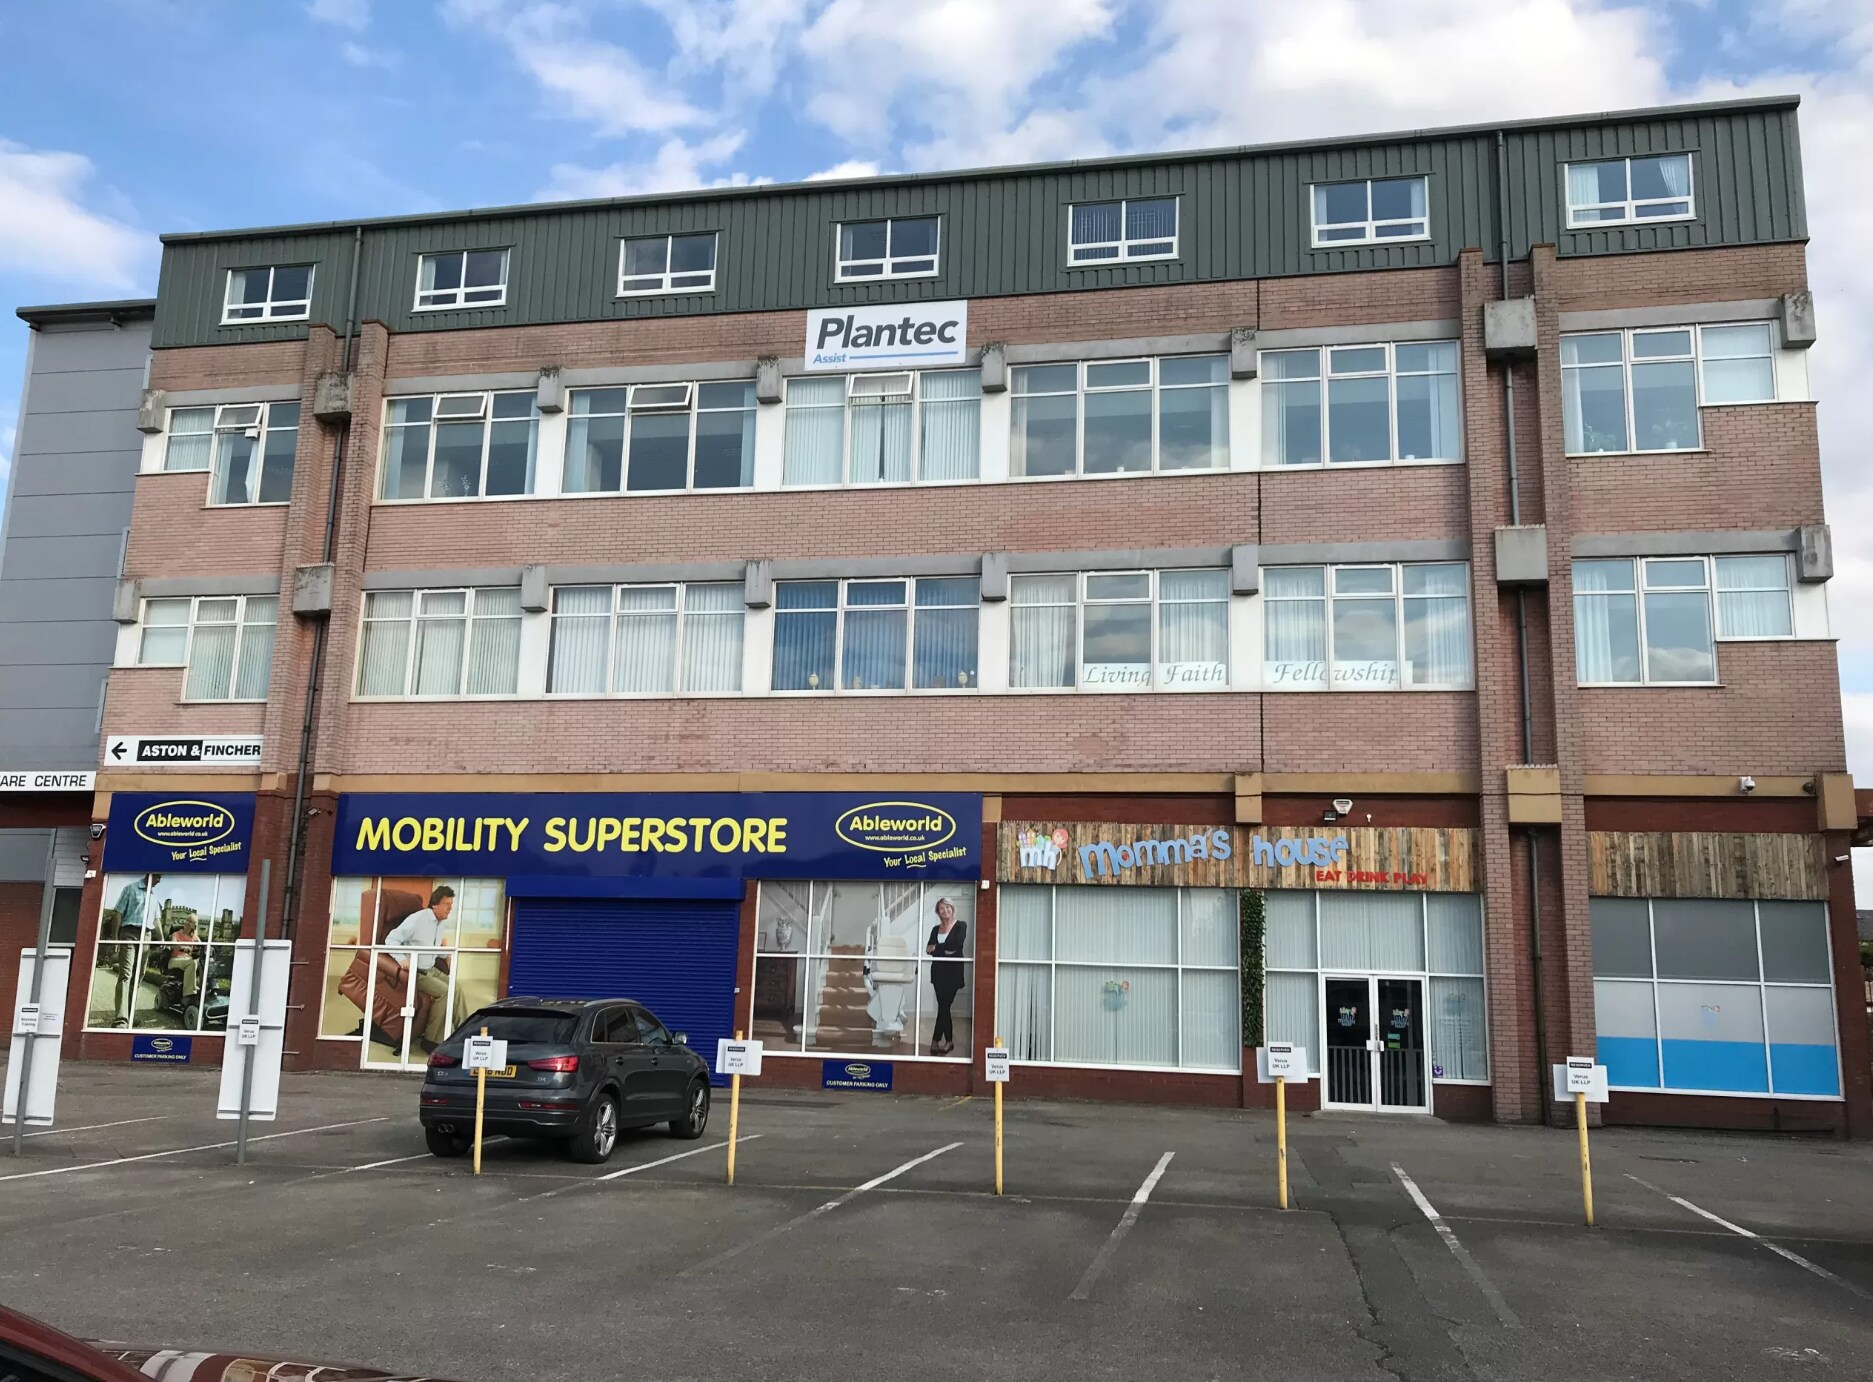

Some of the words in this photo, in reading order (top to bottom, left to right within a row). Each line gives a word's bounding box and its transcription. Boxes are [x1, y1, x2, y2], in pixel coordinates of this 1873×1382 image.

[816, 314, 959, 350] Plantec
[813, 353, 847, 364] Assist
[1083, 666, 1152, 686] Living
[1164, 663, 1224, 685] Faith
[142, 744, 187, 757] ASTON
[190, 744, 200, 757] &
[203, 744, 261, 756] FINCHER
[34, 774, 87, 787] CENTRE
[145, 813, 223, 828] Ableworld
[849, 815, 942, 831] Ableworld
[355, 816, 529, 852] MOBILITY
[543, 816, 788, 854] SUPERSTORE
[171, 851, 187, 861] Your
[189, 846, 207, 860] Local
[209, 842, 241, 855] Specialist
[883, 857, 902, 868] Your
[904, 852, 925, 865] Local
[928, 846, 967, 862] Specialist
[1253, 834, 1349, 868] house
[1316, 870, 1341, 882] EAT
[1346, 870, 1390, 884] DRINK
[1393, 872, 1427, 885] PLAY
